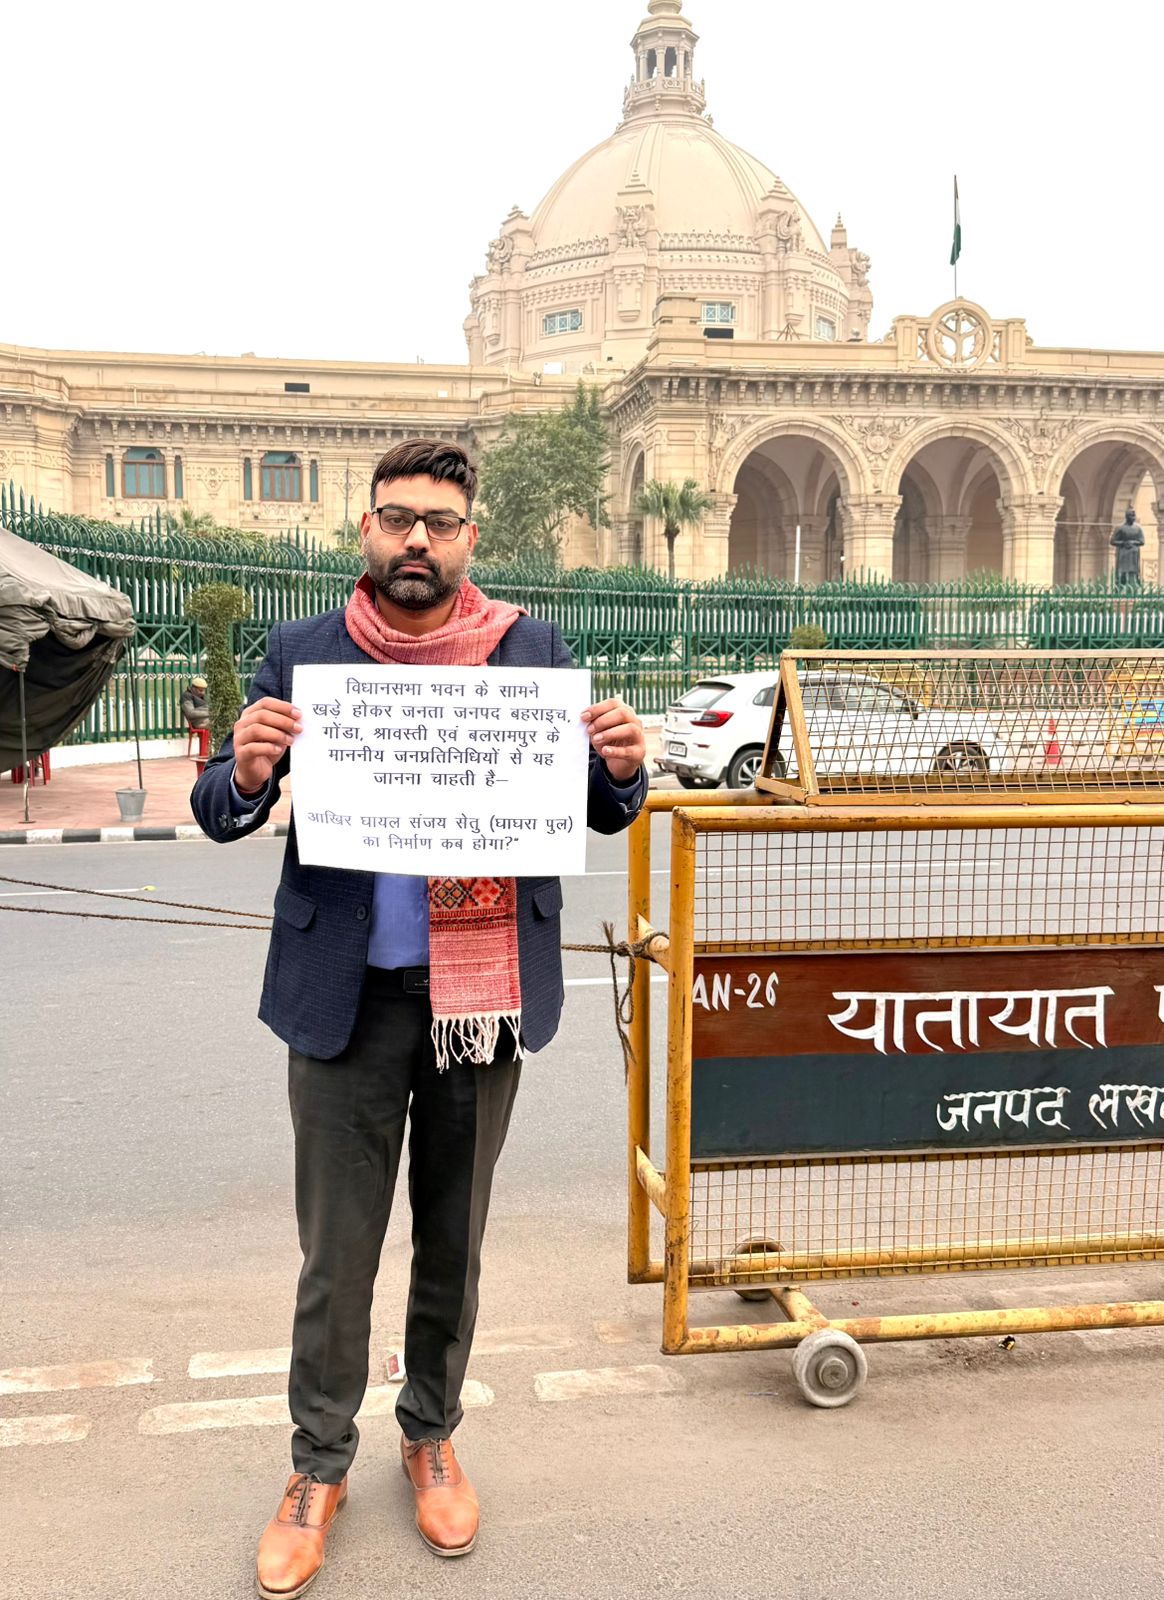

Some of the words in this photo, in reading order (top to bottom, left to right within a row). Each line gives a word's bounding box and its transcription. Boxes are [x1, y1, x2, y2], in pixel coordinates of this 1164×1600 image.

[345, 677, 422, 697] विधानसभा
[431, 683, 466, 698] भवन
[475, 679, 489, 698] के
[499, 680, 540, 699] सामने
[312, 698, 342, 718] खड़े
[352, 699, 392, 718] होकर
[401, 705, 445, 720] जनता
[452, 706, 501, 721] जनपद
[373, 724, 427, 741] श्रावस्ती
[438, 725, 459, 743] एवं
[468, 729, 538, 748] बलरामपुर
[546, 726, 560, 743] के
[328, 746, 385, 763] माननीय
[394, 746, 501, 765] जनप्रतिनिधियों
[509, 748, 523, 766] से
[533, 752, 555, 767] यह
[373, 772, 422, 786] जानना
[430, 769, 476, 787] चाहती
[307, 810, 352, 827] आखिर
[360, 815, 401, 829] घायल
[409, 813, 447, 830] संजय
[456, 812, 481, 834] सेतु
[489, 814, 538, 833] (घाघरा
[545, 815, 574, 835] पुल)
[363, 835, 380, 848] का
[388, 833, 433, 850] निर्माण
[440, 838, 463, 851] कब
[828, 986, 1115, 1056] यातायात
[936, 1086, 1071, 1132] जनपद
[1088, 1083, 1164, 1130] लख
